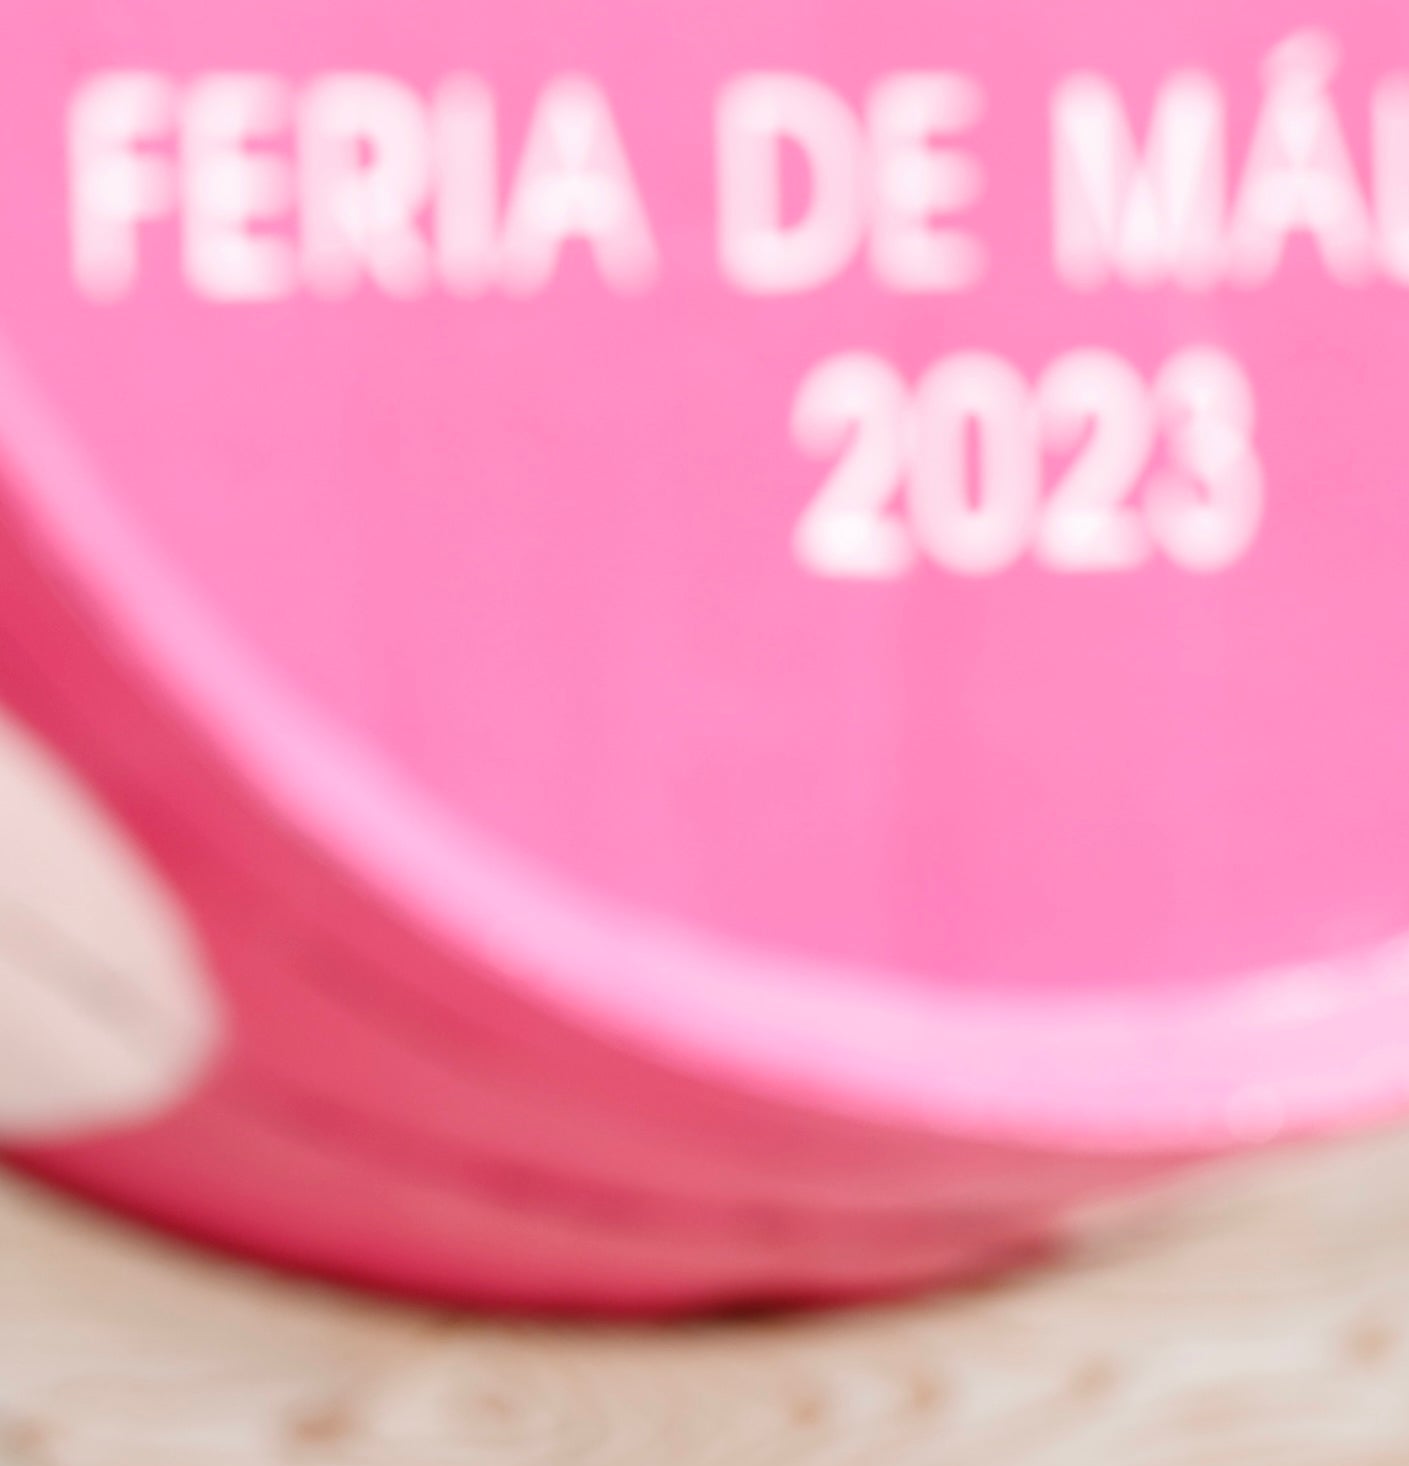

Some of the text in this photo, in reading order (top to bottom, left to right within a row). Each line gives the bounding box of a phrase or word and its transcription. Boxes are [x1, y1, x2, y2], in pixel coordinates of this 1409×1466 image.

[66, 68, 660, 305] FERIA
[714, 69, 990, 296] DE
[789, 346, 1266, 580] 2023
